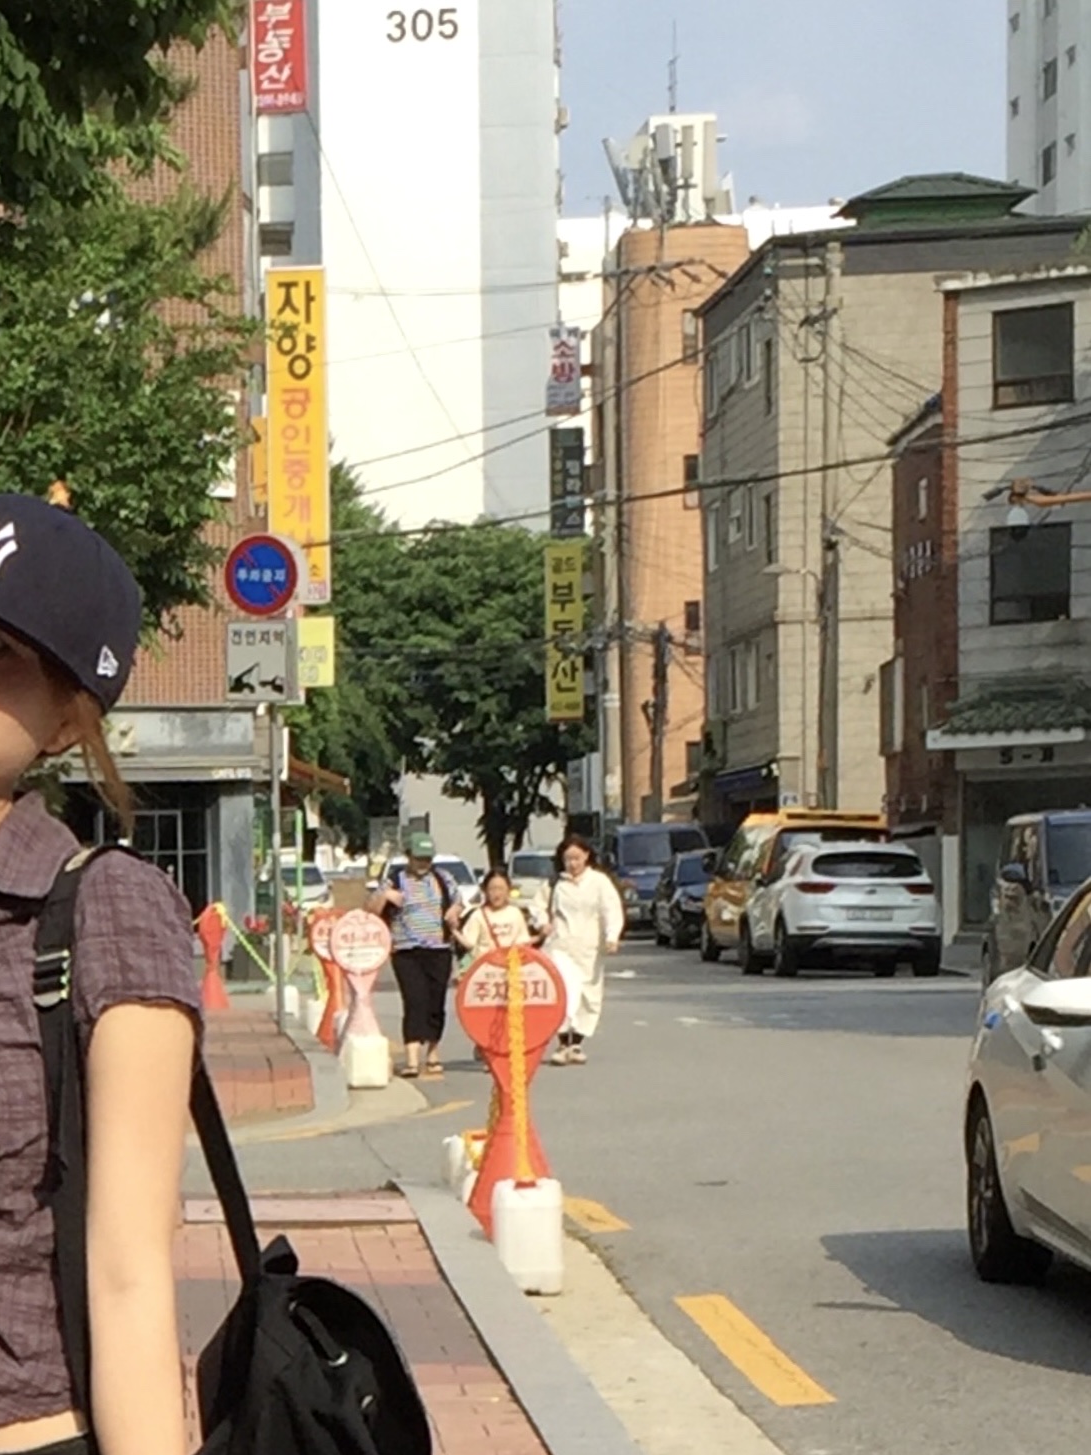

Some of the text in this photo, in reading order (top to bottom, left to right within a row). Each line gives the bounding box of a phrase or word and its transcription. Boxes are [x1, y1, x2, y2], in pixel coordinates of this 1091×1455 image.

[257, 2, 294, 90] 부동산
[386, 8, 459, 43] 305
[277, 280, 316, 380] 자양
[231, 629, 285, 646] 견인지역
[550, 581, 580, 693] 부동산
[473, 980, 548, 1001] 주차지
